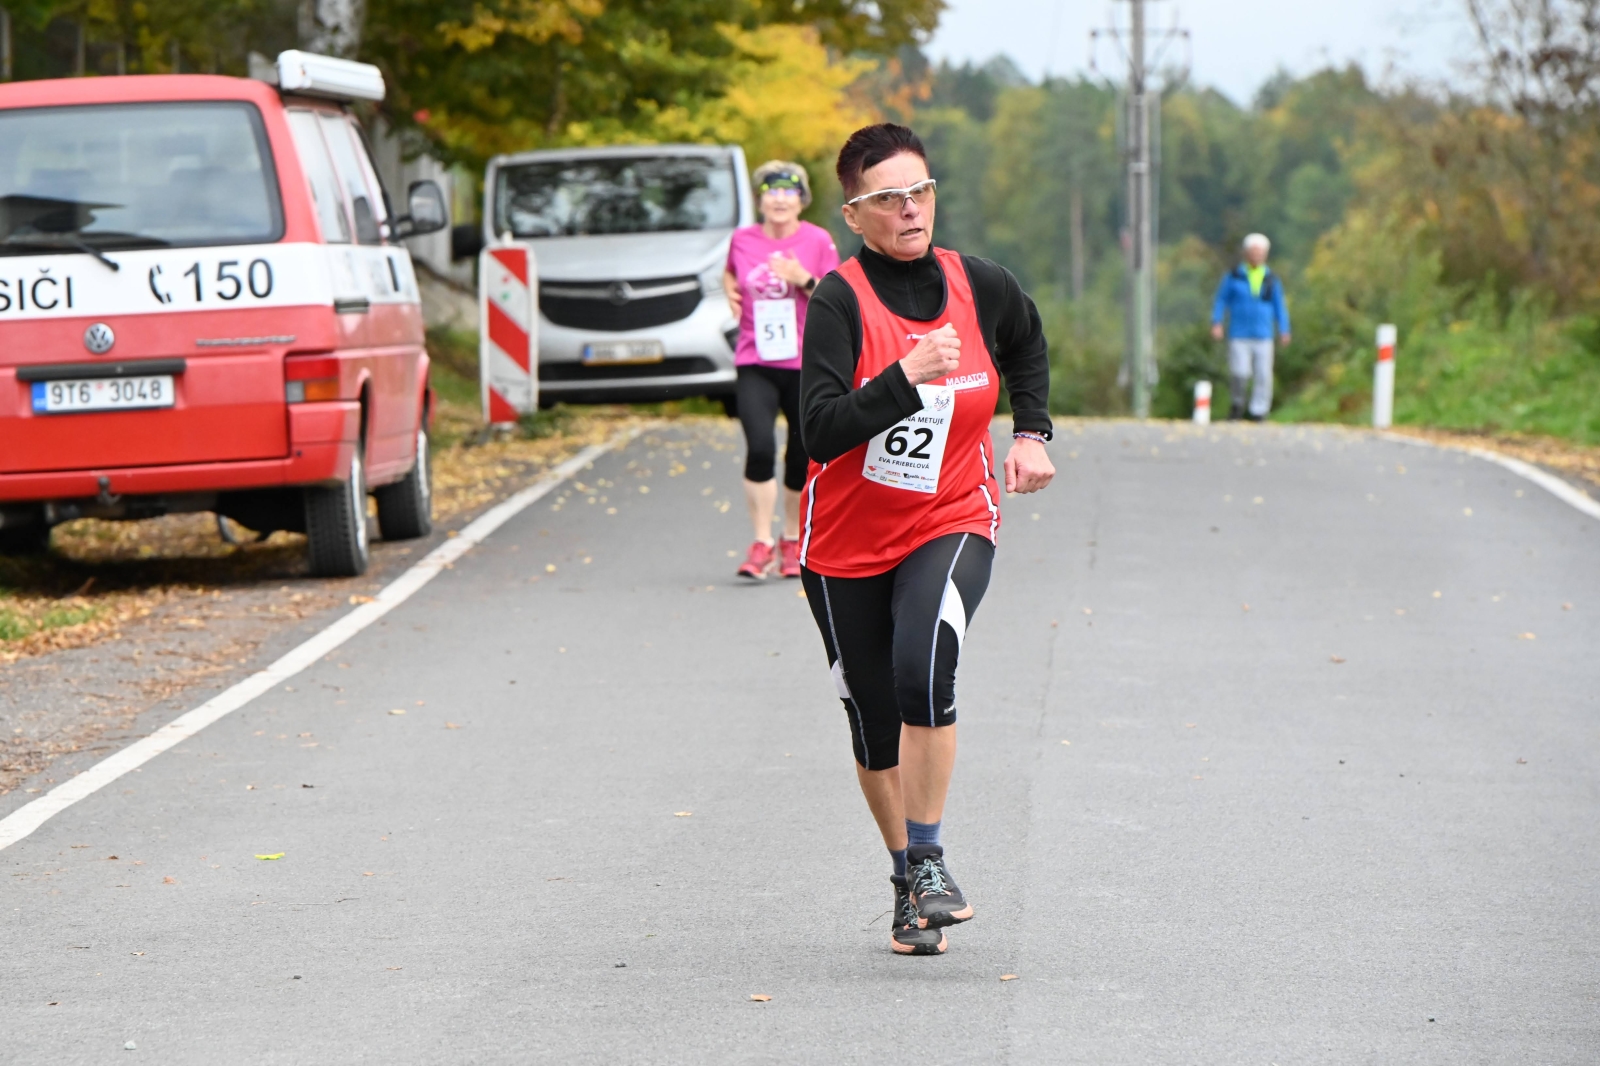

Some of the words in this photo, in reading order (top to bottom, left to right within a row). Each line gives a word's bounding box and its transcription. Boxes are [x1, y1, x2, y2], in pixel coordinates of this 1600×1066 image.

[183, 258, 274, 301] 150
[764, 323, 786, 341] 51
[945, 371, 988, 387] MARATON
[51, 382, 91, 405] 9T6
[109, 379, 162, 402] 3048
[917, 416, 944, 425] METUJE
[885, 426, 933, 459] 62
[878, 456, 891, 464] EVA
[892, 460, 930, 469] FRIEBELOVÁ
